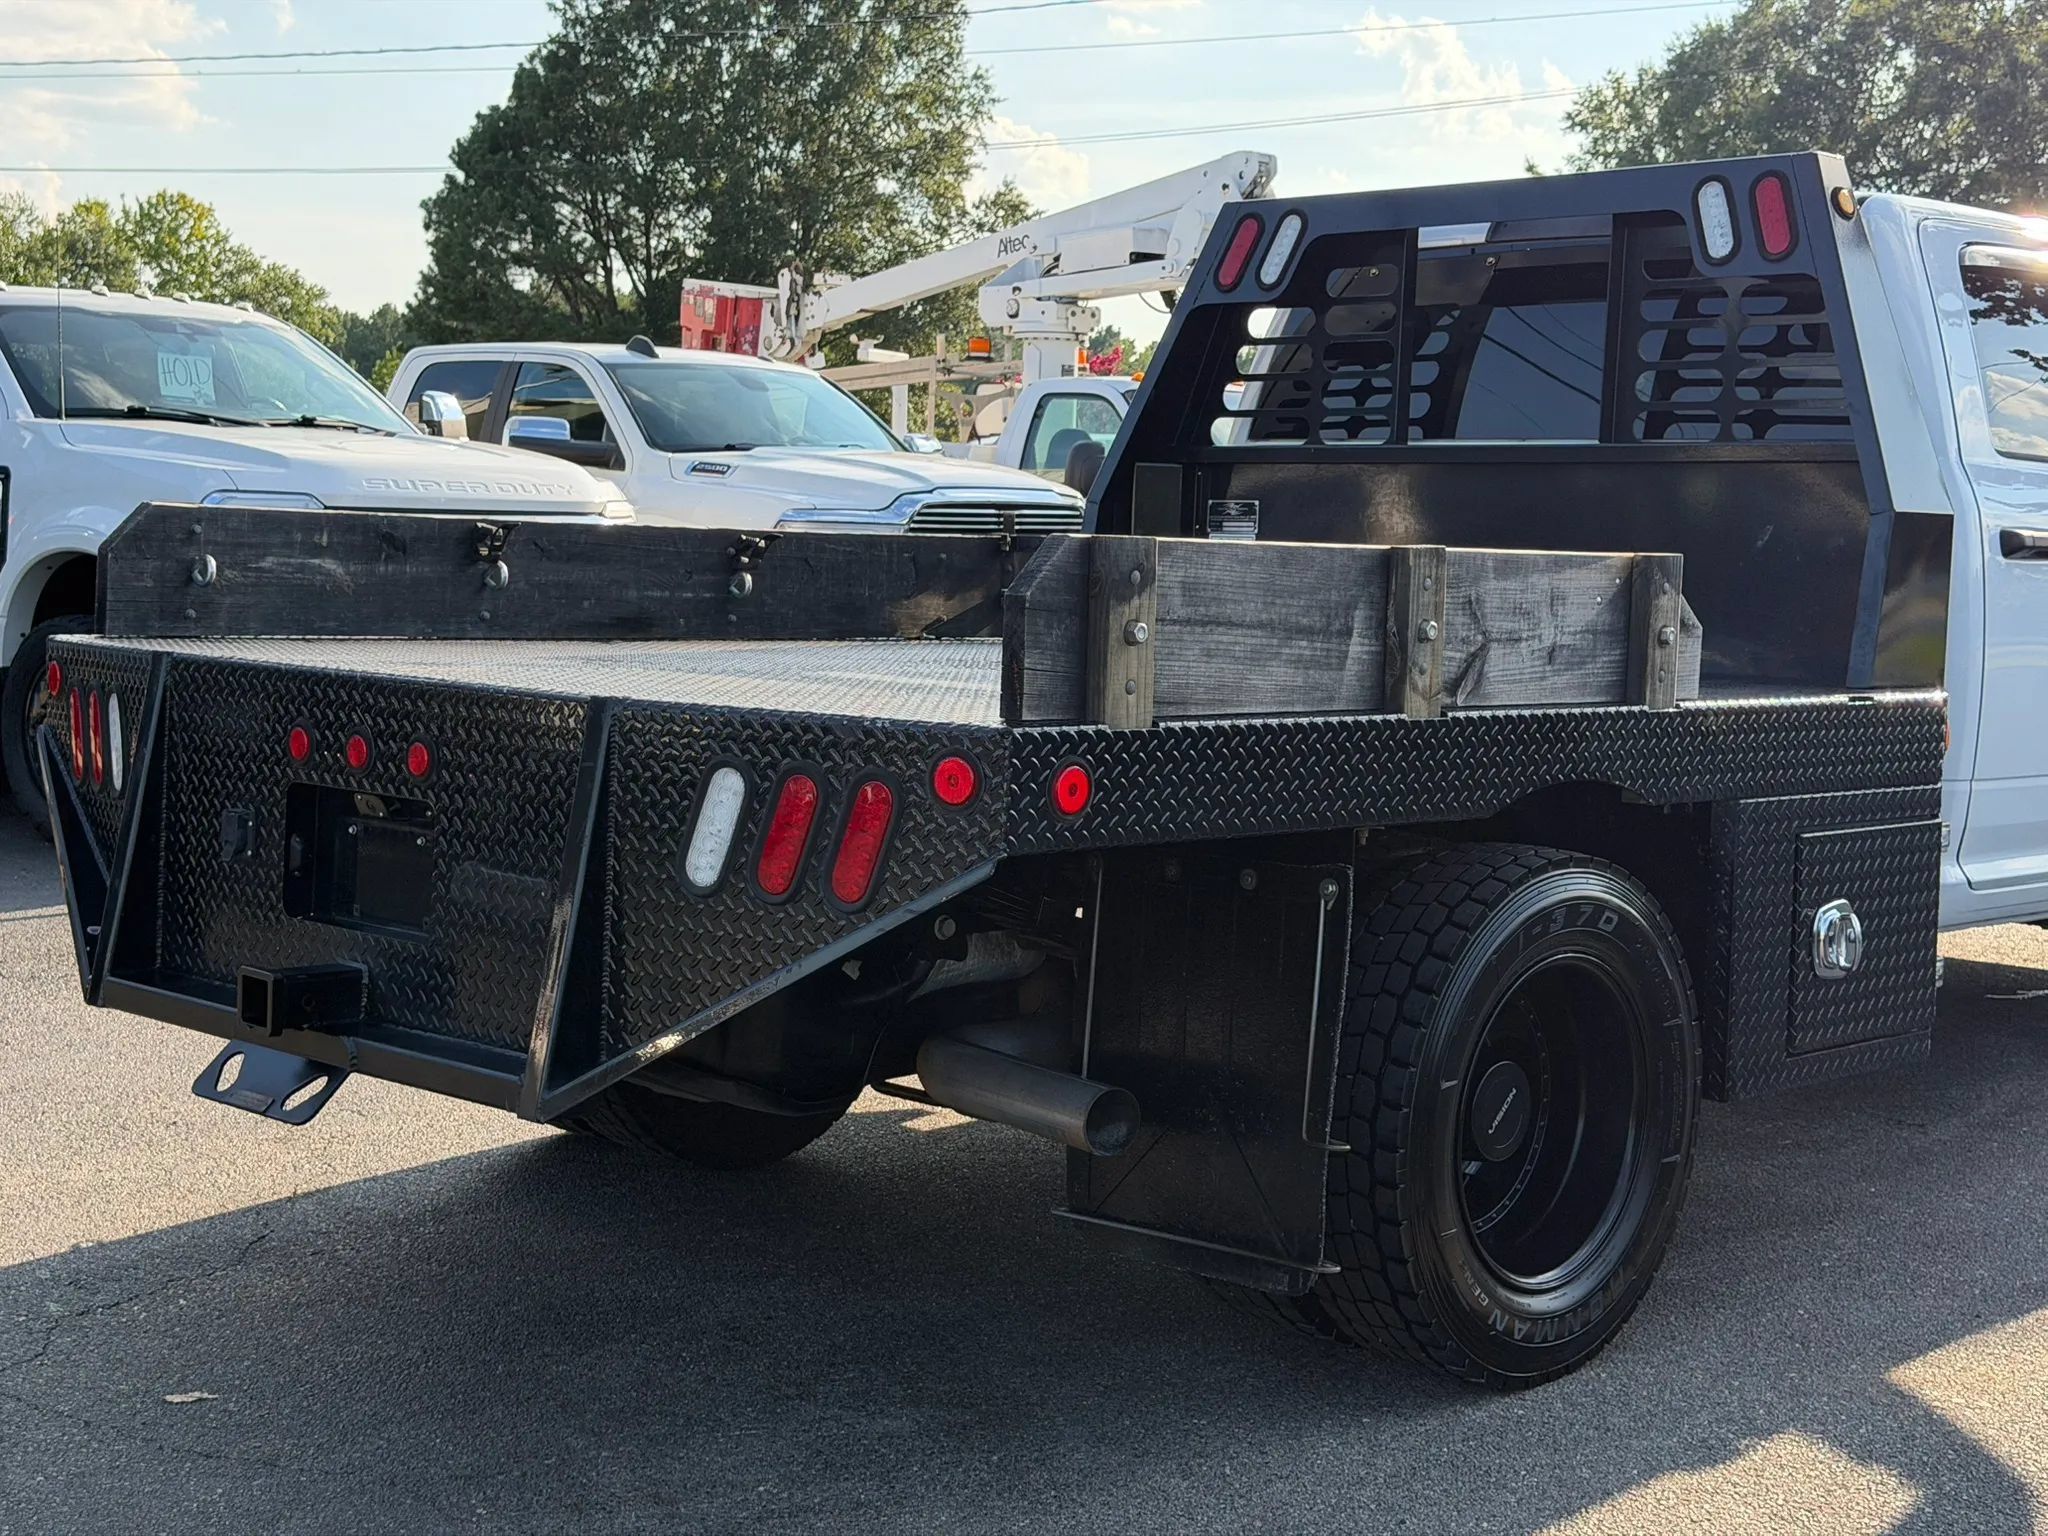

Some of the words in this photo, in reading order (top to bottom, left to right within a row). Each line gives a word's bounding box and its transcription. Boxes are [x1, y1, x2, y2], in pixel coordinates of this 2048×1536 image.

[997, 234, 1031, 258] Altec
[161, 357, 211, 388] HOLD
[695, 463, 729, 472] 2500
[361, 477, 491, 495] SUPER
[495, 481, 576, 497] DUTY
